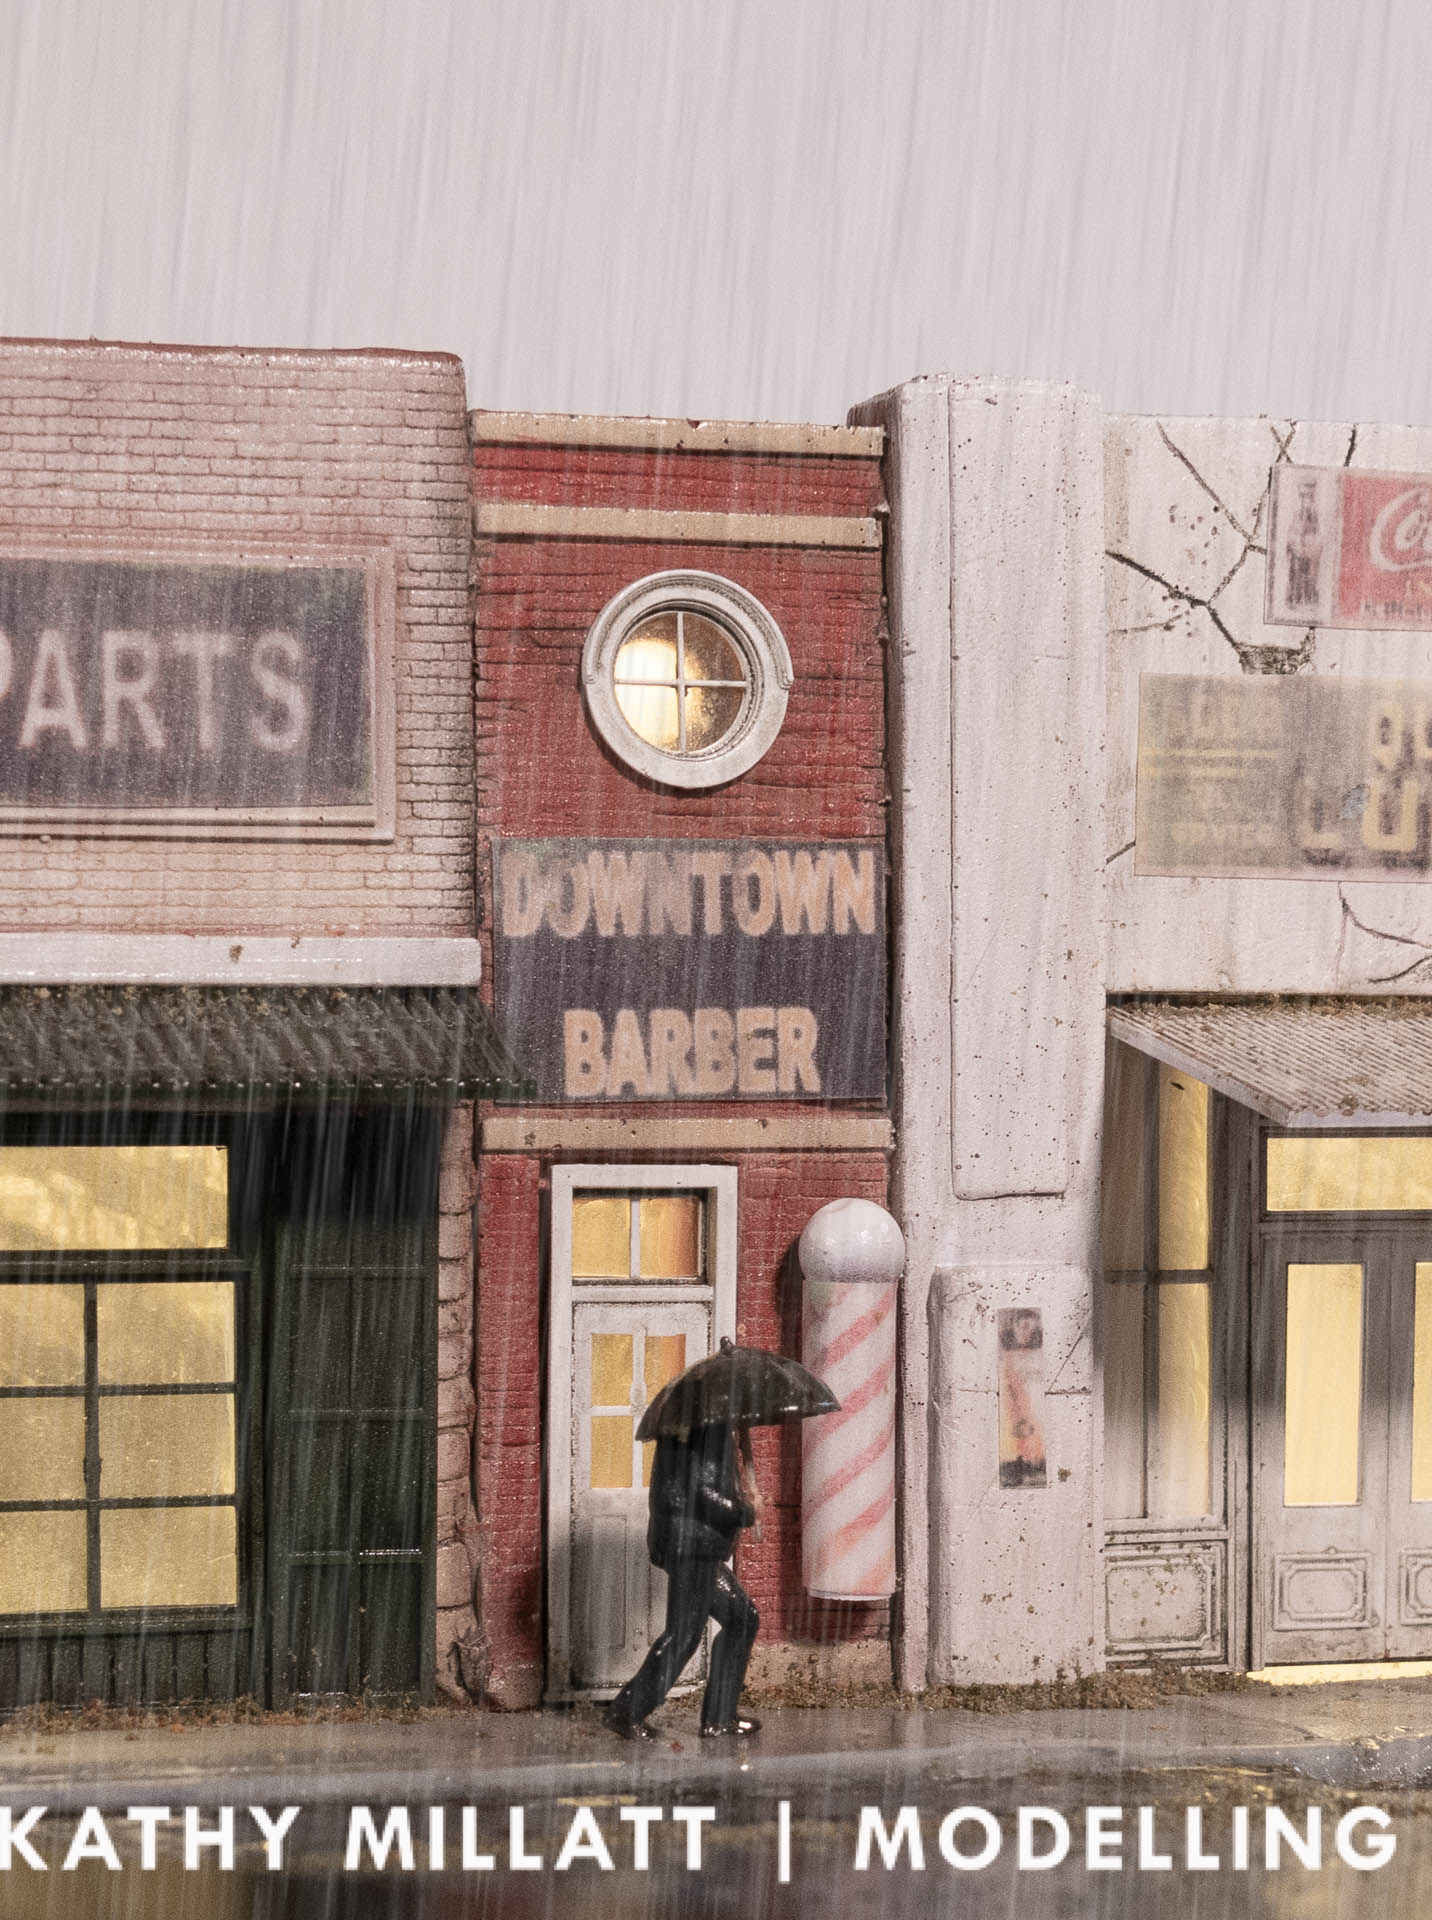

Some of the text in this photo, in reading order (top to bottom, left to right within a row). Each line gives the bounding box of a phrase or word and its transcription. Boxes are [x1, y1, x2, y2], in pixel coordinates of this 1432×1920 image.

[0, 627, 311, 752] ARTS
[502, 849, 875, 939] DOWNTOWN
[564, 1006, 823, 1097] BARBER
